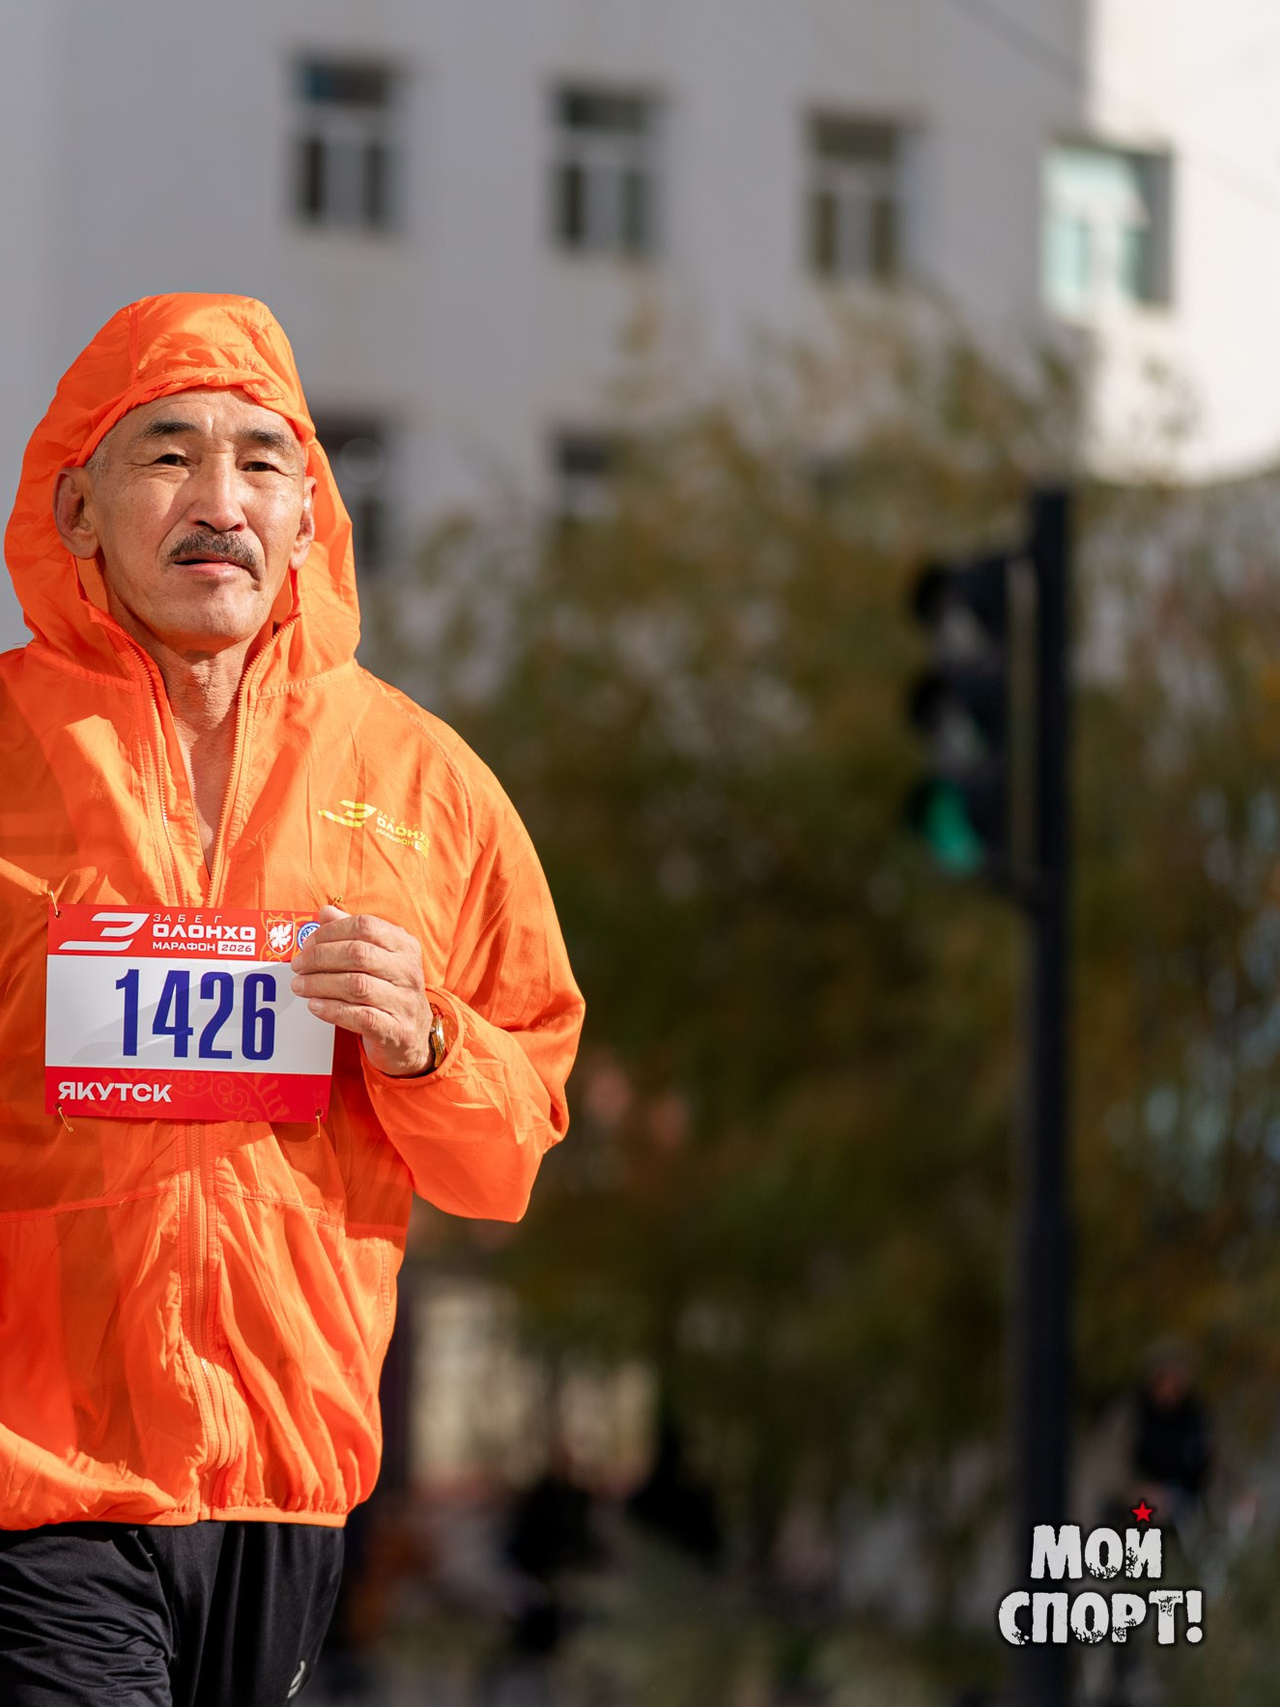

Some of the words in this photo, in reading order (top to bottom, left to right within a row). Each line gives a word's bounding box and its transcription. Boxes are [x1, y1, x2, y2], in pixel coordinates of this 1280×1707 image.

[152, 913, 223, 924] ЗАБЕГ
[152, 923, 256, 941] ОЛОНХО
[152, 941, 216, 952] МАРАФОН
[221, 943, 252, 953] 2026
[115, 968, 277, 1061] 1426
[57, 1080, 172, 1103] ЯКУТСК
